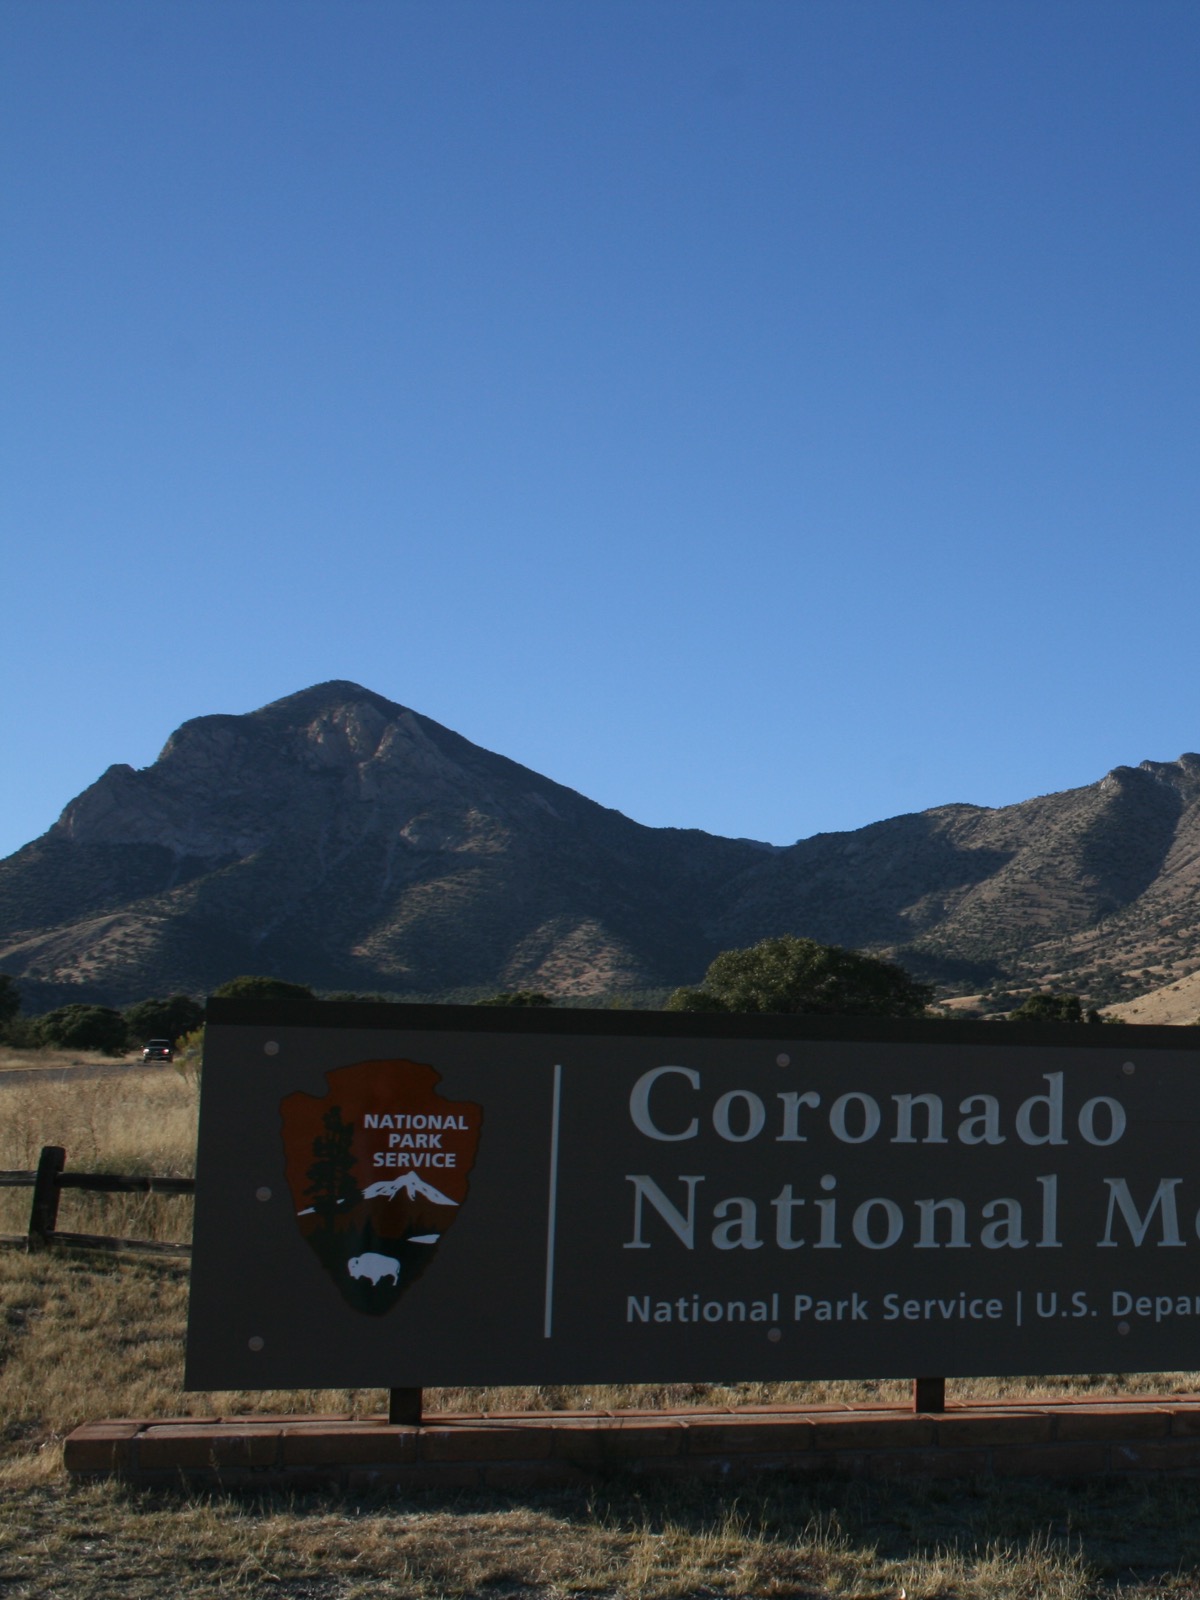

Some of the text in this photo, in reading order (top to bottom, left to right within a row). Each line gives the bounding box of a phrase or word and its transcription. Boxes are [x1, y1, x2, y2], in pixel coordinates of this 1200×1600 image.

[629, 1065, 1127, 1147] Coronado
[364, 1113, 469, 1130] NATIONAL
[388, 1133, 442, 1149] PARK
[373, 1151, 456, 1168] SERVICE
[622, 1173, 1063, 1250] National
[626, 1292, 779, 1323] National
[794, 1292, 869, 1321] Park
[883, 1291, 1003, 1321] Service
[1036, 1291, 1097, 1318] U.S.
